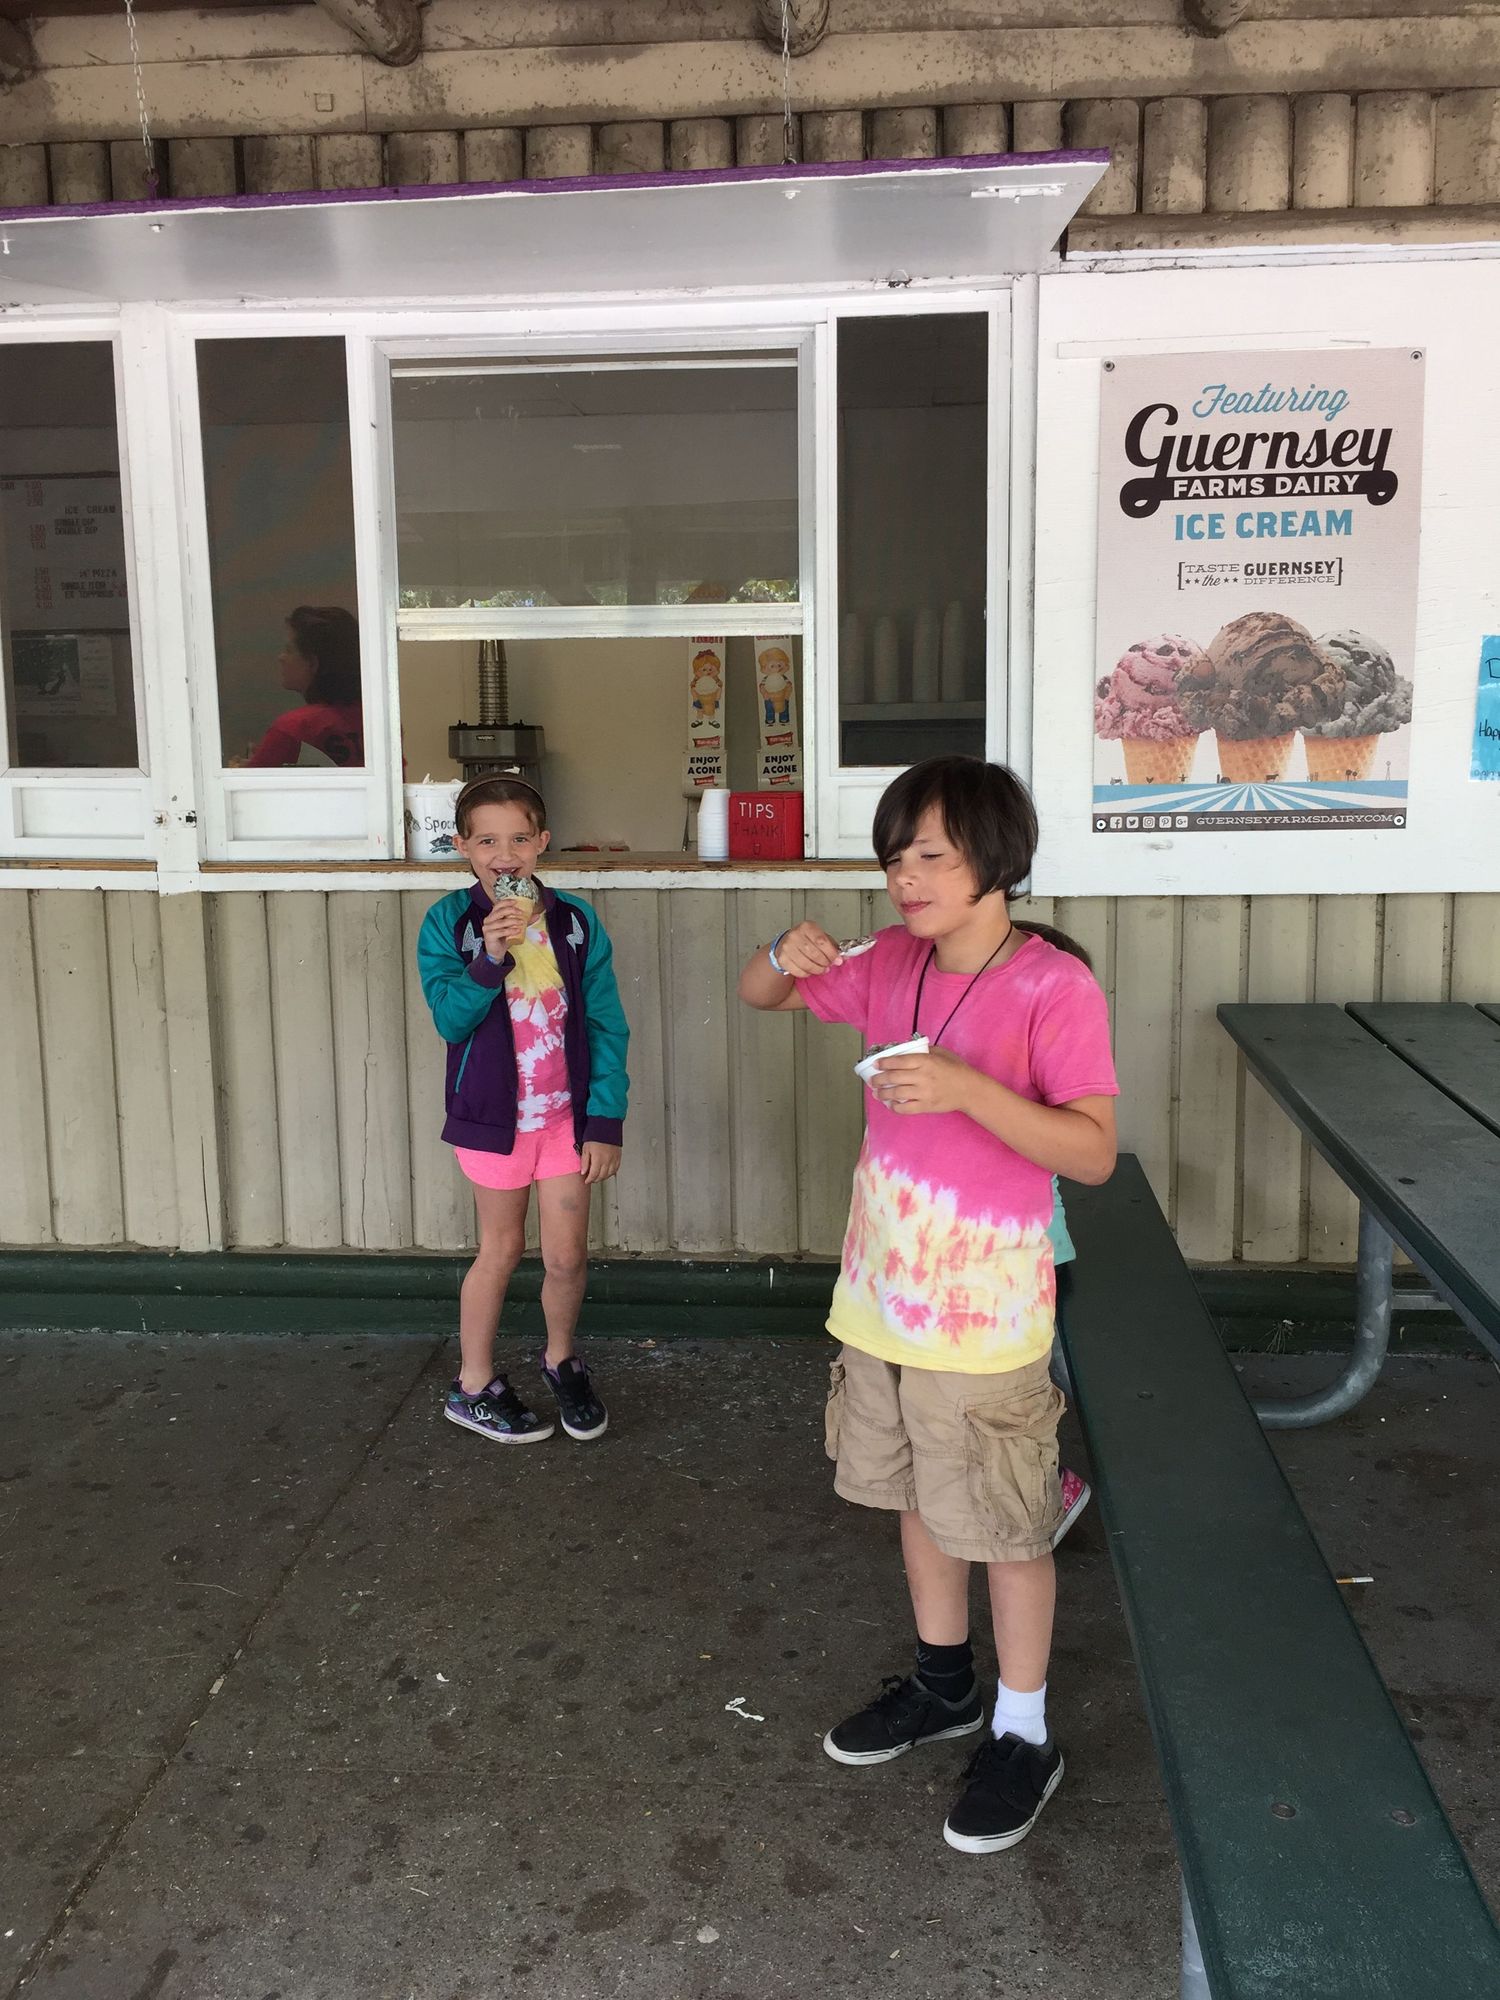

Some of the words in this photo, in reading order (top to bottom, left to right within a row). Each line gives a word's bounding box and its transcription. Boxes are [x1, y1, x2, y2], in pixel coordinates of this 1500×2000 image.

[1192, 383, 1349, 421] Featuring
[1122, 403, 1396, 500] Guernsey
[1173, 475, 1265, 498] FARMS
[1275, 473, 1360, 495] DAIRY
[1174, 512, 1226, 541] ICE
[1235, 509, 1353, 539] CREAM
[1185, 563, 1240, 574] TASTE
[1243, 560, 1336, 577] GUERNSEY
[1201, 574, 1221, 587] the
[1243, 575, 1336, 585] DIFFERENCE
[690, 756, 720, 765] ENJOY
[765, 754, 795, 764] ENJOY
[687, 766, 695, 775] A
[696, 766, 722, 775] CONE
[763, 766, 770, 775] A
[770, 765, 797, 774] CONE
[738, 801, 774, 819] TIPS
[1196, 813, 1393, 826] GUERNSEYFARMSDAIRY.COM
